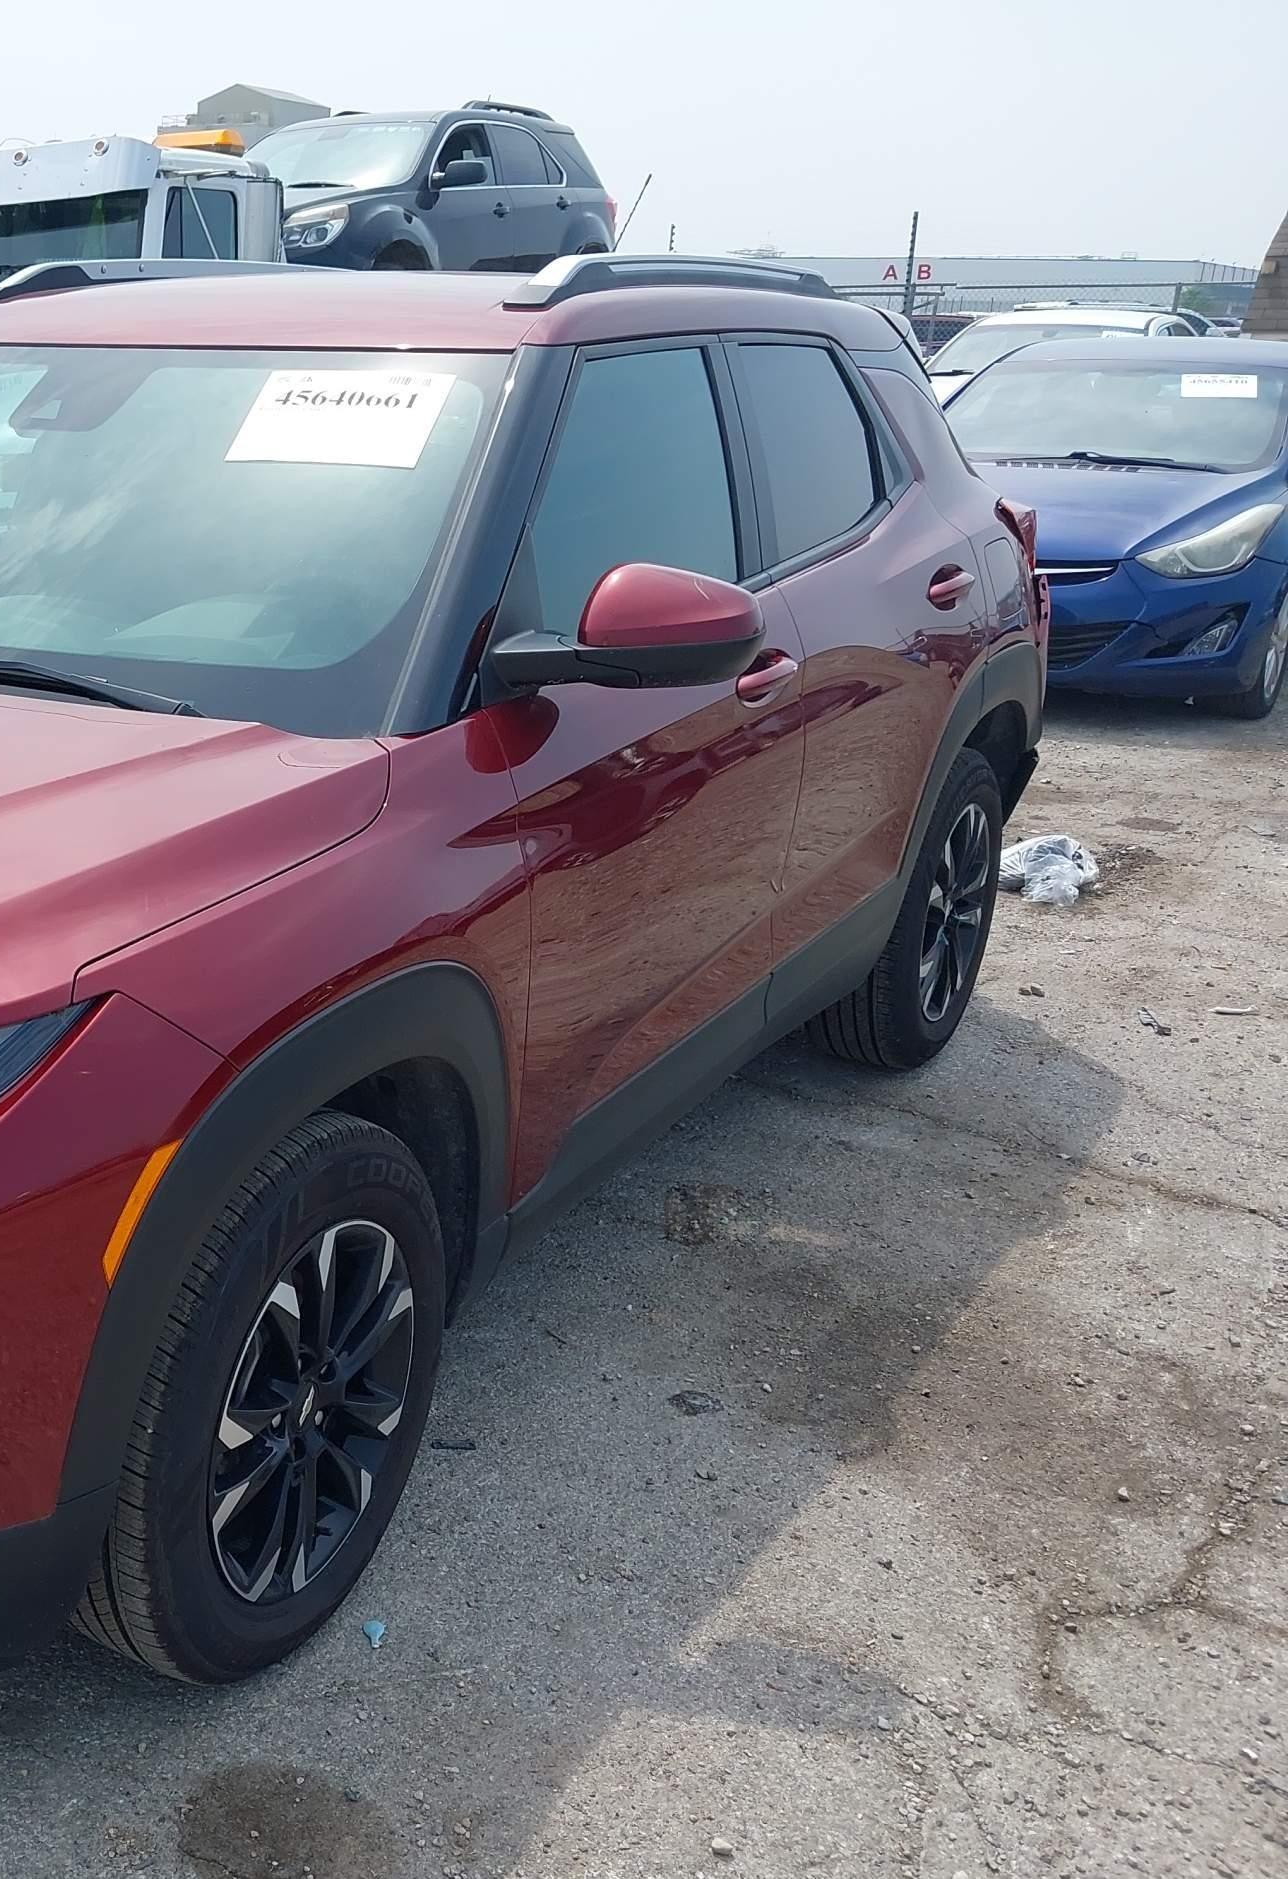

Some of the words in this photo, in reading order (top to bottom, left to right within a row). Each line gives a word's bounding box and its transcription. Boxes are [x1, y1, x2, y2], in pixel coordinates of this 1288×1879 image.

[882, 264, 899, 281] A
[917, 264, 932, 281] B
[275, 390, 418, 409] 45640661
